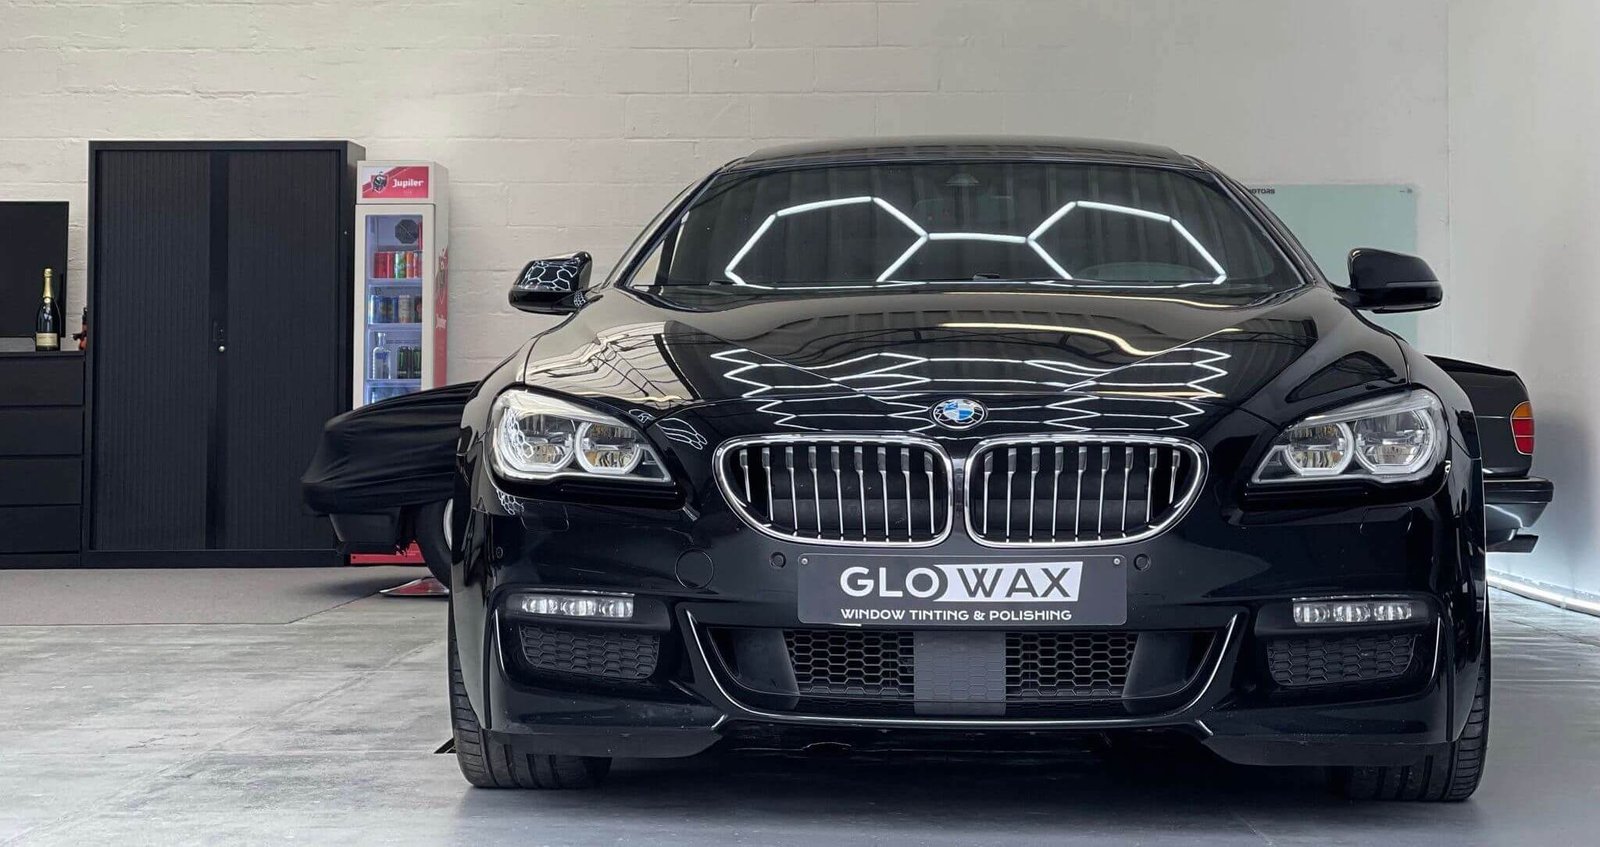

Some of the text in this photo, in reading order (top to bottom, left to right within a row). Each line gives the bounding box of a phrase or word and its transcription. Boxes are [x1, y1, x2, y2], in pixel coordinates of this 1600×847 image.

[392, 178, 425, 189] Jupiler
[840, 608, 1073, 621] WINDOW TINTING & POLISHING
